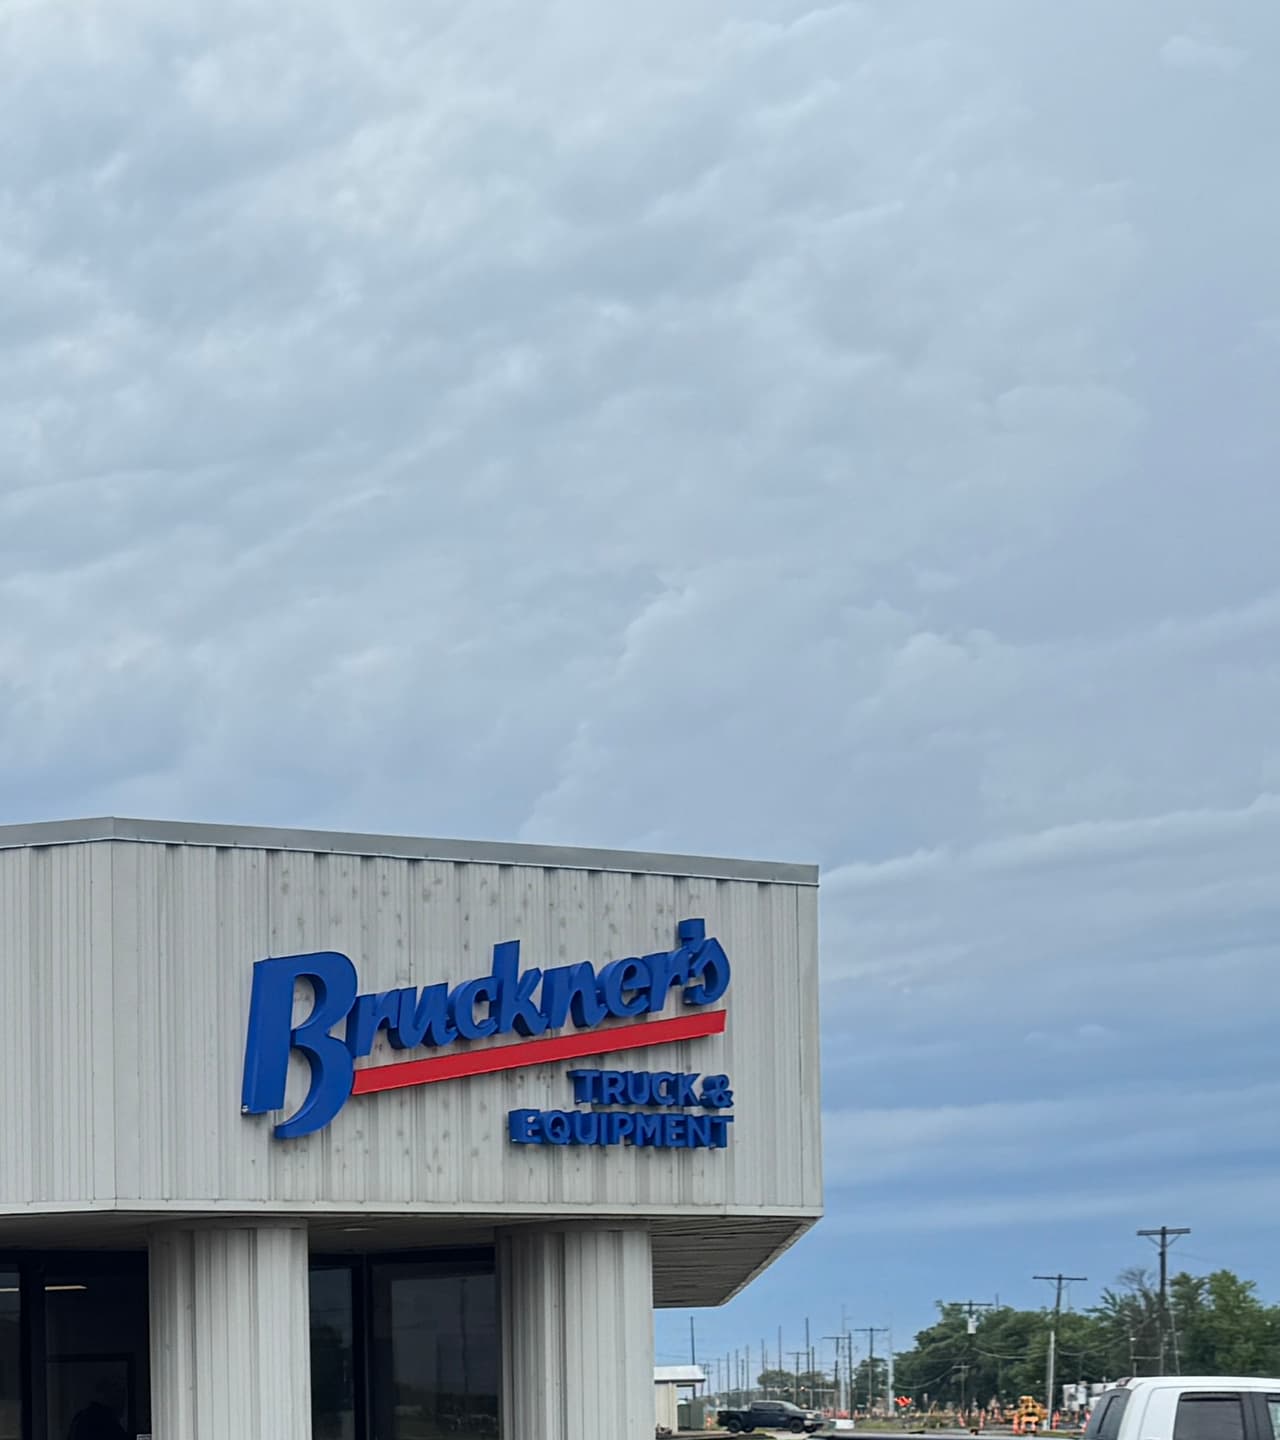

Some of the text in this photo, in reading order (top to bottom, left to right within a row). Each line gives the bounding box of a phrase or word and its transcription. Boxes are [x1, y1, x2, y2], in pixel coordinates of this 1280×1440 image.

[241, 918, 731, 1139] Bruckner's
[567, 1068, 734, 1108] TRUCK &
[508, 1108, 735, 1148] EQUIPMENT
